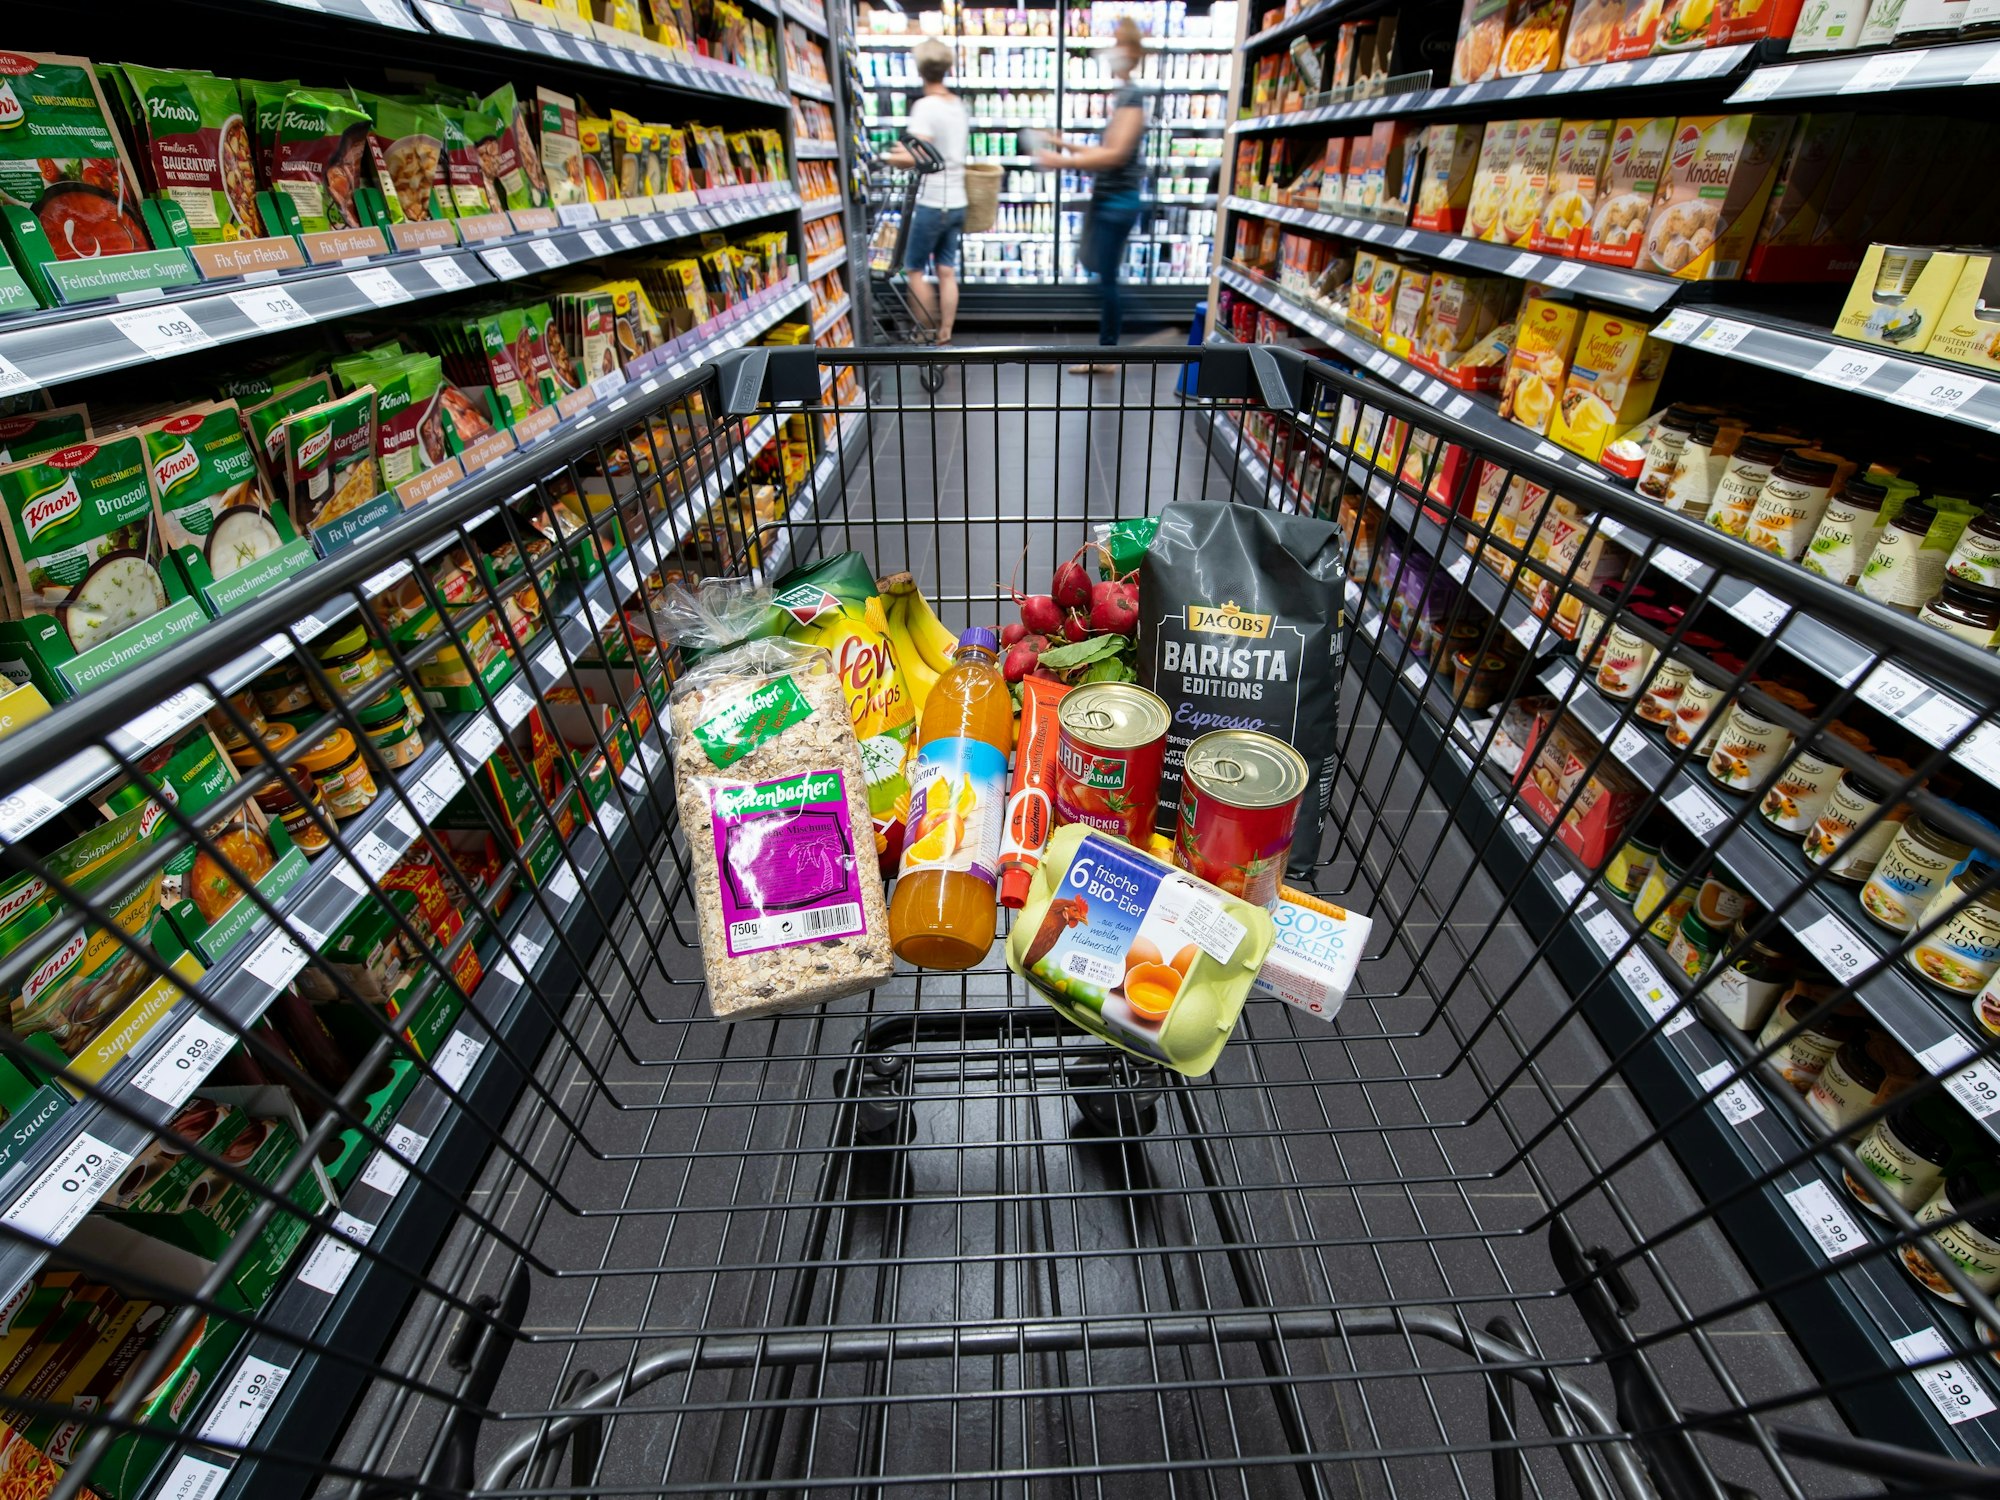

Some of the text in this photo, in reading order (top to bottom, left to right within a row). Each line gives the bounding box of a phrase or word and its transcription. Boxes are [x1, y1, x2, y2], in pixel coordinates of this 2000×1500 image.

[148, 97, 199, 122] Knorr
[28, 122, 109, 137] Strauchtomaten
[283, 111, 327, 132] Knorr
[158, 141, 199, 155] Familien-Fix
[1637, 148, 1664, 160] Semmel
[1704, 149, 1737, 164] Semmel
[162, 155, 217, 172] BAUERNTOPF
[1567, 155, 1598, 176] Knödel
[1623, 159, 1659, 180] Knödel
[1686, 162, 1732, 185] Knödel
[319, 235, 377, 257] Fix für Fleisch
[403, 226, 448, 246] Fix für Fleisch
[215, 246, 289, 271] Fix für Fleisch
[59, 259, 190, 290] Feinschmecker Suppe
[266, 299, 295, 314] 0.79
[158, 321, 192, 337] 0.99
[1842, 316, 1881, 331] FISCH-PASTE
[1587, 334, 1627, 360] Kartoffel
[1717, 329, 1739, 342] 2.99
[1933, 334, 1988, 352] KRUSTENTIER-
[1592, 353, 1618, 372] Püree
[1943, 345, 1967, 357] PASTE
[1841, 362, 1869, 376] 0.99
[379, 391, 410, 411] Knorr
[1930, 385, 1964, 401] 0.99
[63, 449, 83, 460] Extra
[299, 433, 329, 459] Knorr
[155, 452, 196, 485] Knorr
[410, 469, 454, 498] Fix für Fleisch
[1765, 480, 1811, 501] Lacroix
[25, 490, 78, 528] Knorr
[95, 481, 147, 516] Broccoli
[329, 503, 389, 543] Fix für Gemüse
[1756, 510, 1785, 526] FOND
[216, 547, 310, 606] Feinschmecker Suppe
[1195, 611, 1264, 633] JACOBS
[1922, 613, 1953, 630] Lacroix
[75, 608, 201, 686] Feinschmecker Suppe
[1613, 630, 1645, 649] Lacroix
[486, 660, 507, 683] Bouillon
[1164, 640, 1289, 683] BARISTA
[1182, 675, 1264, 701] EDITIONS
[1878, 681, 1905, 700] 1.99
[850, 682, 901, 725] Chips
[1175, 702, 1266, 731] Espresso
[1731, 713, 1772, 736] Lacroix
[482, 723, 499, 738] 1.79
[1619, 737, 1635, 752] 2.99
[1722, 739, 1750, 756] FOND
[1084, 769, 1122, 786] PARMA
[416, 790, 436, 809] 1.79
[786, 822, 833, 836] Mischung
[1029, 795, 1041, 846] Händlmaier
[1079, 813, 1120, 829] STÜCKIG
[1695, 810, 1716, 831] 2.99
[366, 841, 390, 862] 1.79
[1895, 838, 1948, 871] Lacroix
[276, 857, 304, 891] Suppe
[1069, 858, 1139, 896] 6 frische
[1882, 866, 1916, 892] FOND
[1885, 849, 1934, 888] FISCH
[0, 880, 43, 917] norr
[425, 890, 445, 914] Pack
[1087, 880, 1146, 919] BIO-Eier
[1089, 926, 1119, 942] mobilen
[1114, 921, 1132, 933] dem
[1273, 904, 1348, 949] 30%
[1071, 931, 1122, 957] Hühnerstall
[1604, 929, 1622, 948] 7.29
[1946, 933, 1994, 959] FOND
[27, 933, 85, 997] Knorr
[1829, 943, 1858, 969] 2.99
[1632, 965, 1651, 985] 0.59
[1280, 991, 1293, 1001] 150
[97, 983, 176, 1063] Suppenliebe
[431, 1003, 451, 1036] Soße
[147, 1034, 187, 1076] GRIESSKLOESSCHEN
[176, 1039, 209, 1070] 0.89
[457, 1038, 474, 1058] 1.29
[1961, 1069, 1998, 1102] 2.99
[1724, 1087, 1748, 1113] 2.99
[14, 1098, 60, 1146] Sauce
[9, 1138, 87, 1220] KN. CHAMPIGNON RAHM SAUCE
[62, 1153, 103, 1193] 0.79
[1820, 1213, 1848, 1244] 2.99
[173, 1374, 198, 1416] Knorr
[239, 1373, 268, 1411] 1.99
[1936, 1369, 1972, 1408] 2.99
[207, 1384, 239, 1432] FLEISCH BOUILLON
[176, 1473, 198, 1500] 4305
